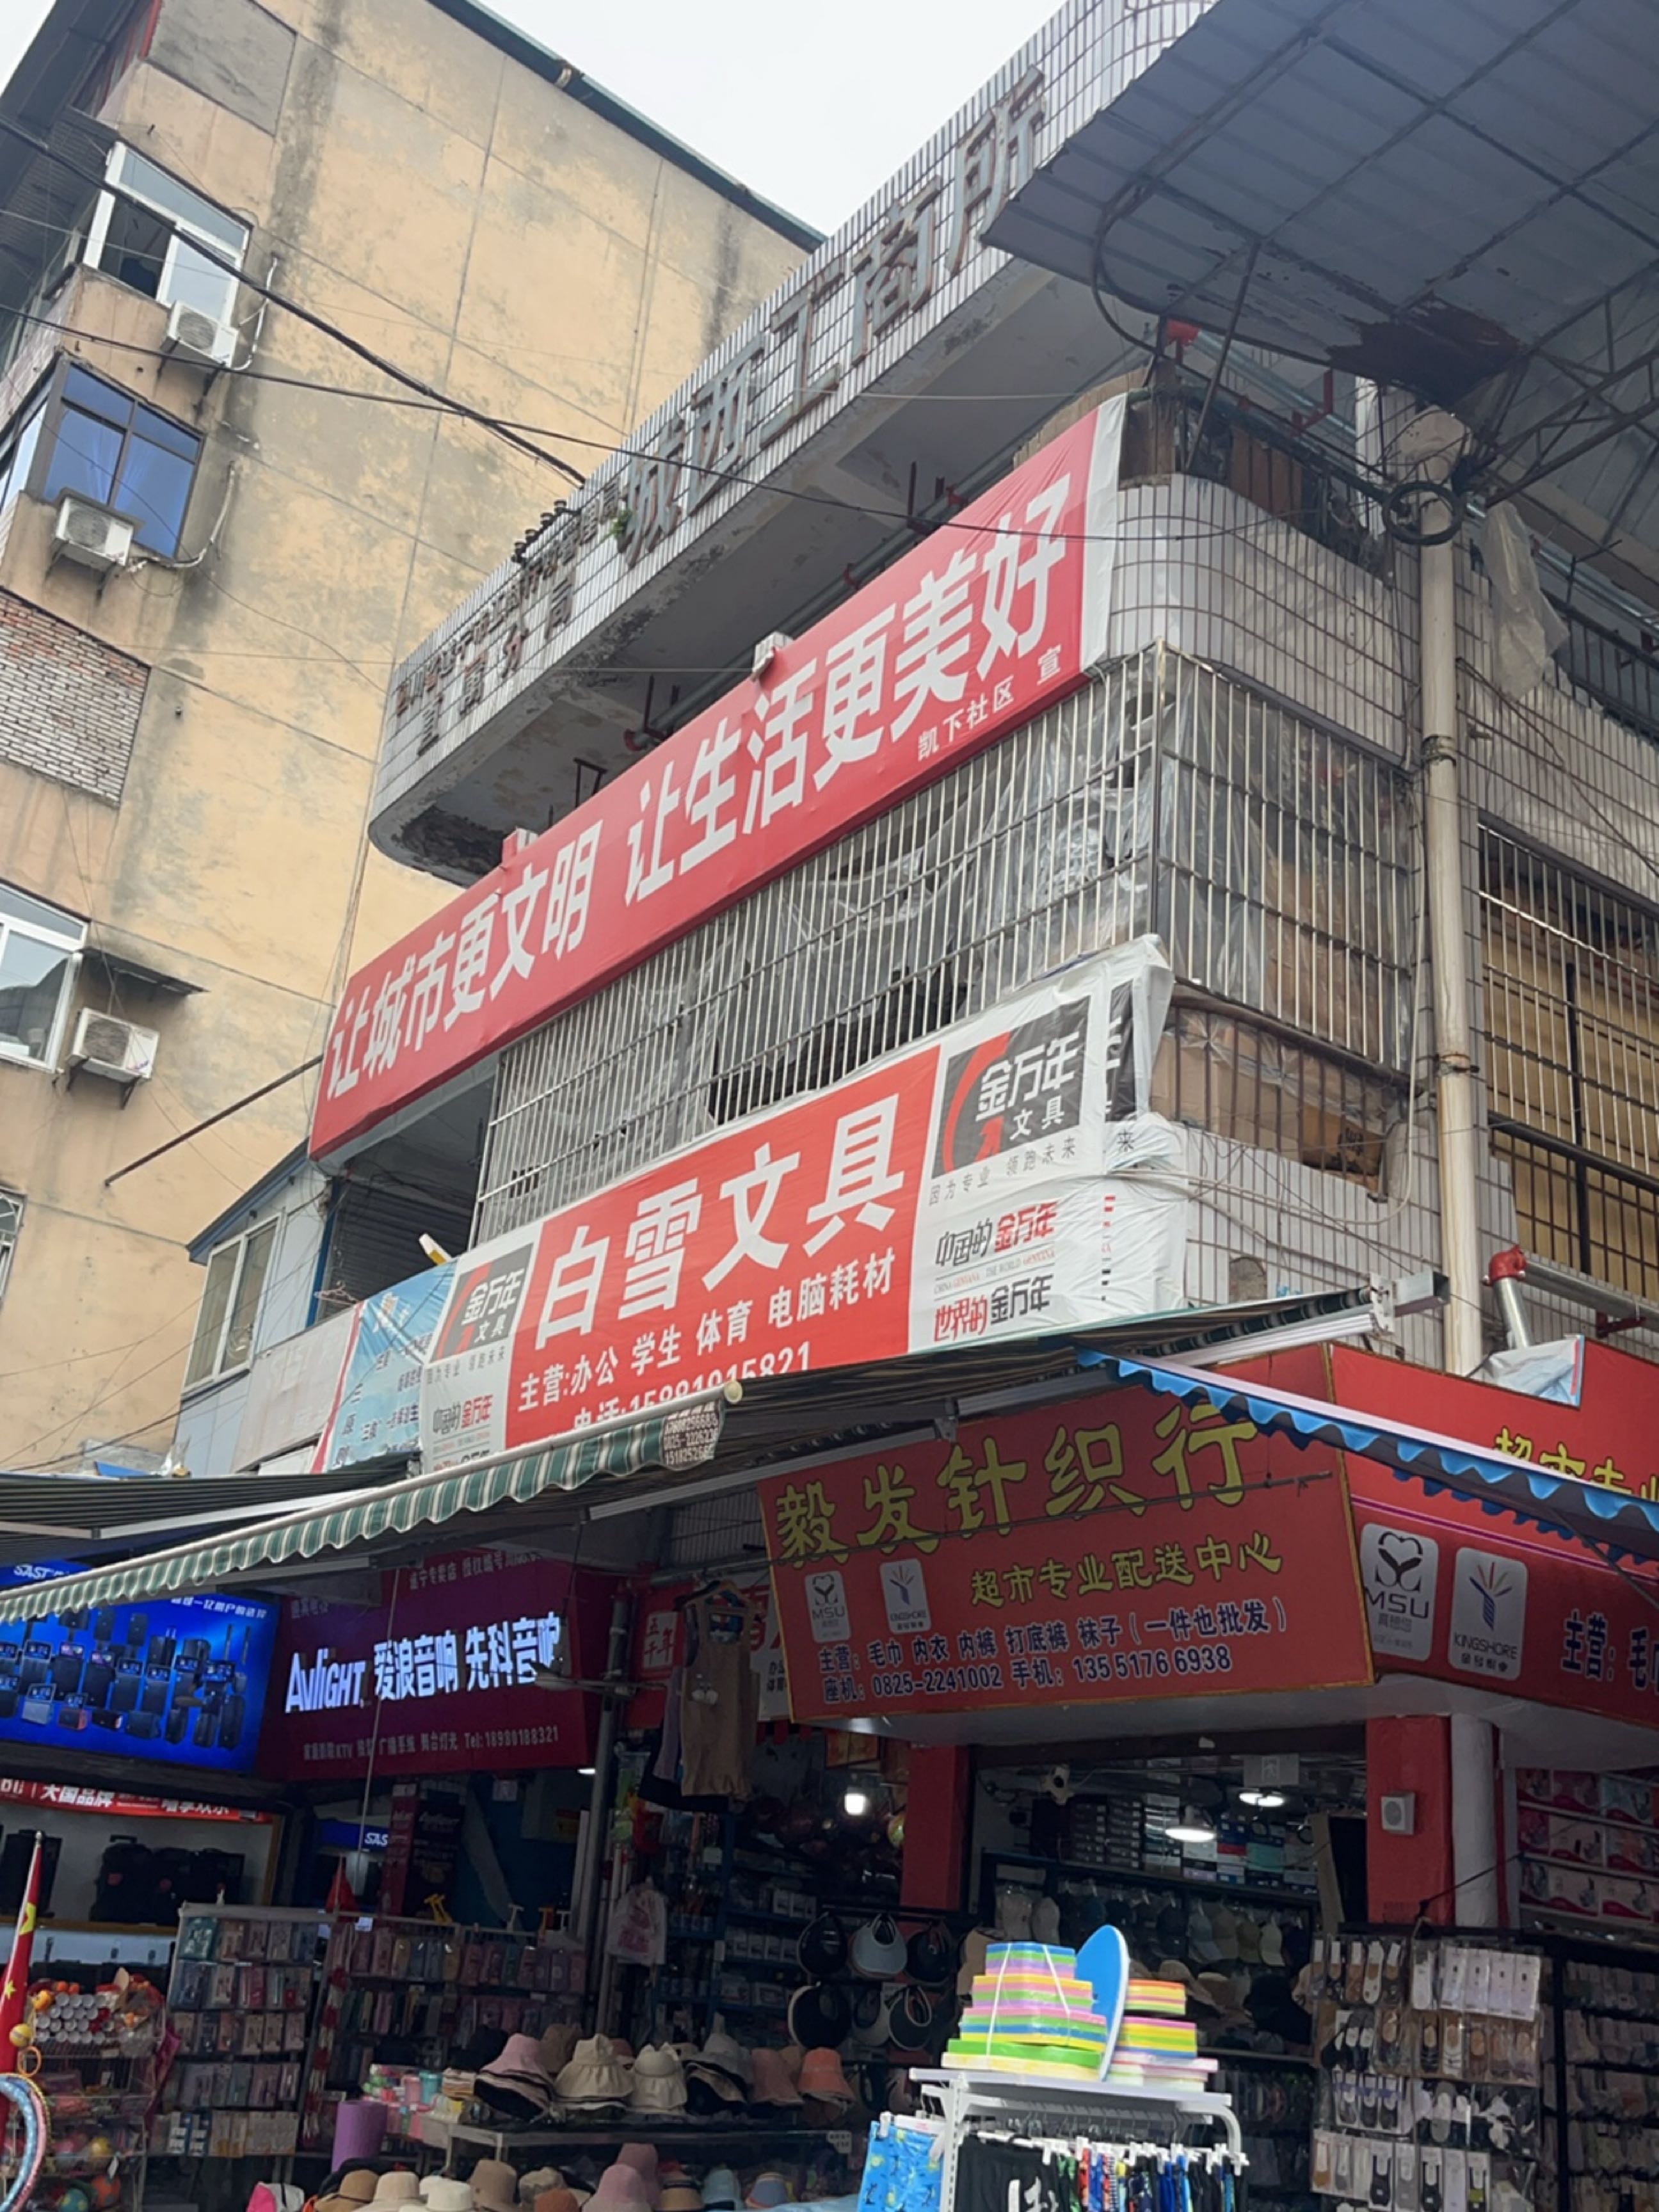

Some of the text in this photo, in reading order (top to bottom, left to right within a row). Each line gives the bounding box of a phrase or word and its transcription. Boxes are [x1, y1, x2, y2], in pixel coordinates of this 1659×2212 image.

[917, 652, 1062, 762] 凯下社区 宣
[326, 472, 1074, 1100] 让城市更文明 让生活更美好
[977, 1032, 1080, 1121] 金万年
[1010, 1096, 1066, 1139] 文具
[535, 1093, 904, 1350] 白雪文具
[935, 1201, 1059, 1267] 中国的金万年
[461, 1269, 525, 1326] 金万年
[474, 1315, 506, 1343] 文具
[518, 1247, 895, 1413] 主营:办公 学生 体育 电脑耗材
[934, 1274, 1054, 1342] 世界的金万年
[775, 1404, 1258, 1569] 毅发针织行
[970, 1530, 1283, 1608] 超市专业配送中心
[812, 1606, 845, 1620] MSU
[1365, 1587, 1429, 1619] MSU
[374, 1630, 459, 1701] 爱浪音响
[465, 1612, 561, 1692] 先科音响
[868, 1639, 902, 1668] 毛巾
[913, 1631, 949, 1664] 内衣
[959, 1624, 998, 1658] 内裤
[1006, 1617, 1069, 1654] 打底裤
[1078, 1616, 1122, 1648] 袜子
[1454, 1631, 1518, 1660] KINGSHORE
[1630, 1629, 1659, 1693] 毛
[872, 1665, 1003, 1699] 0825-2241002
[40, 1783, 116, 1808] 大国品牌
